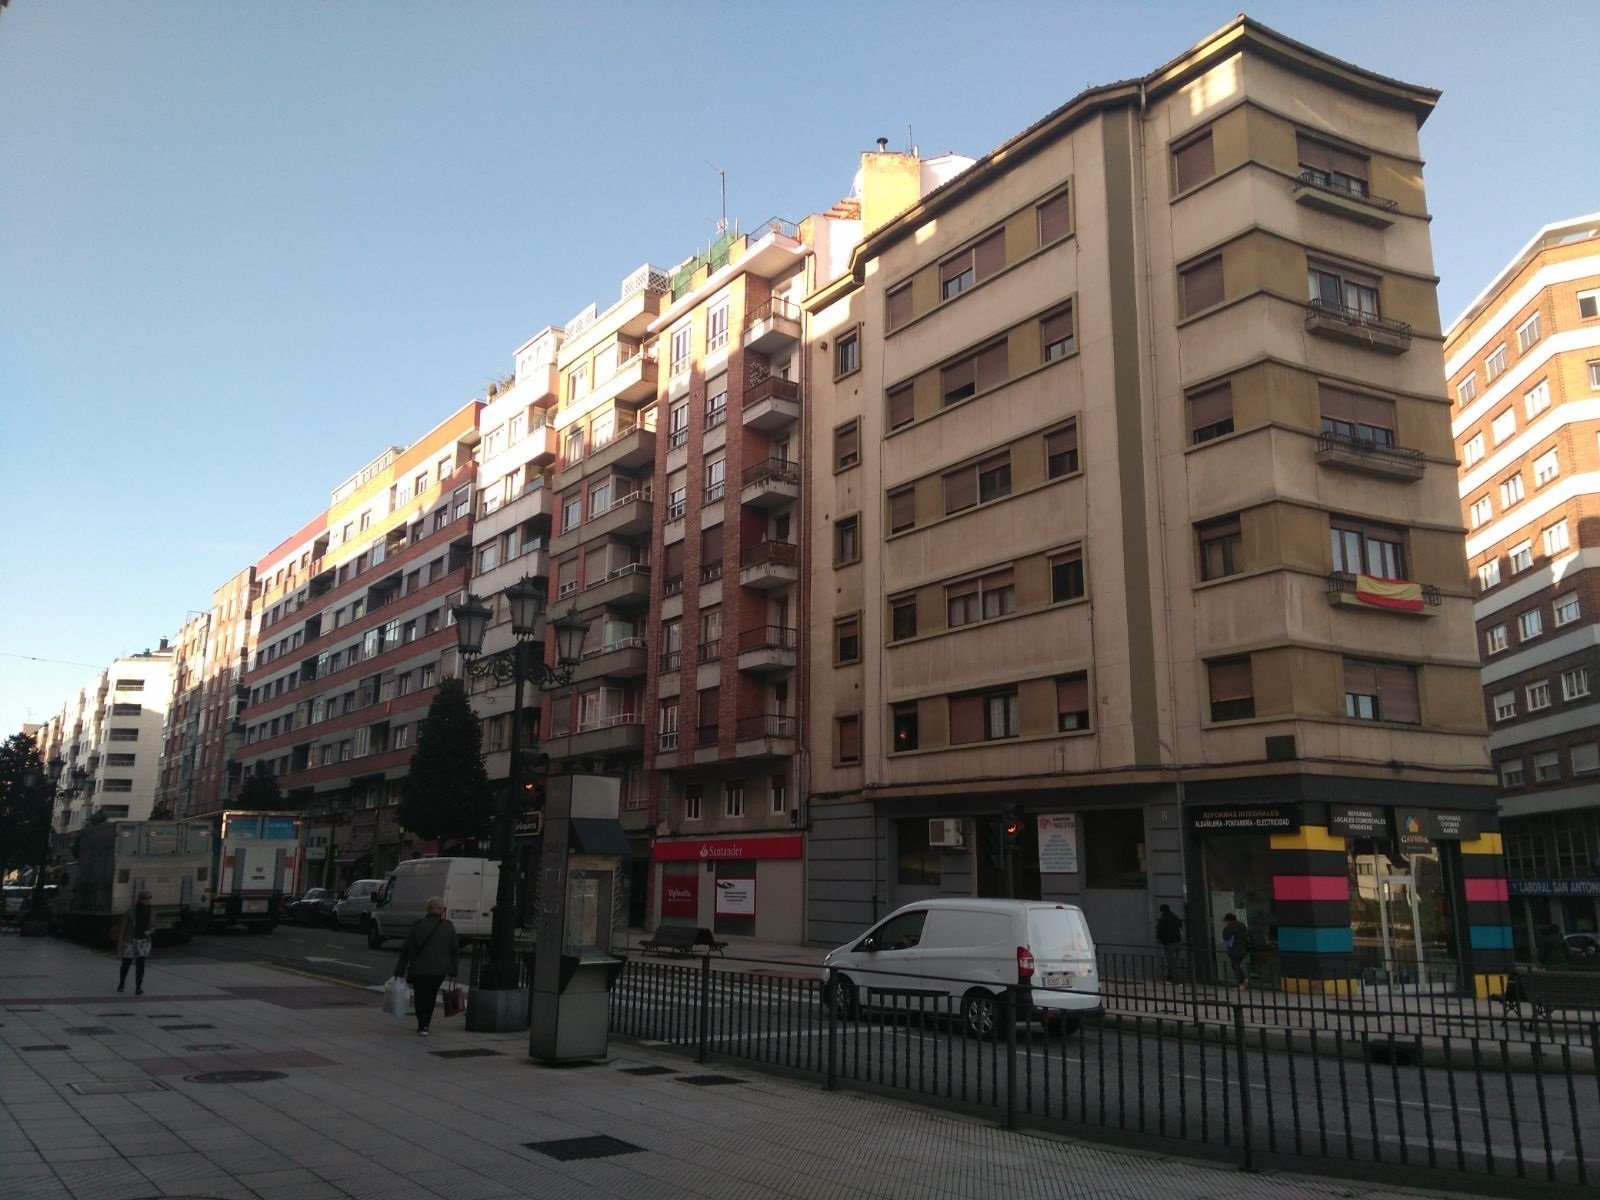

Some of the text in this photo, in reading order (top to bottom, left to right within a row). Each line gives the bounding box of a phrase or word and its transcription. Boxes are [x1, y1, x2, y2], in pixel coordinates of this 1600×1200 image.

[1203, 810, 1280, 819] REFORMAS INTEGRALES
[1256, 817, 1290, 826] ELECTRICIDAD
[1355, 817, 1386, 825] COMERCIALES
[709, 844, 742, 856] Santander
[1520, 881, 1551, 893] LABORAL
[1553, 881, 1569, 893] SAN
